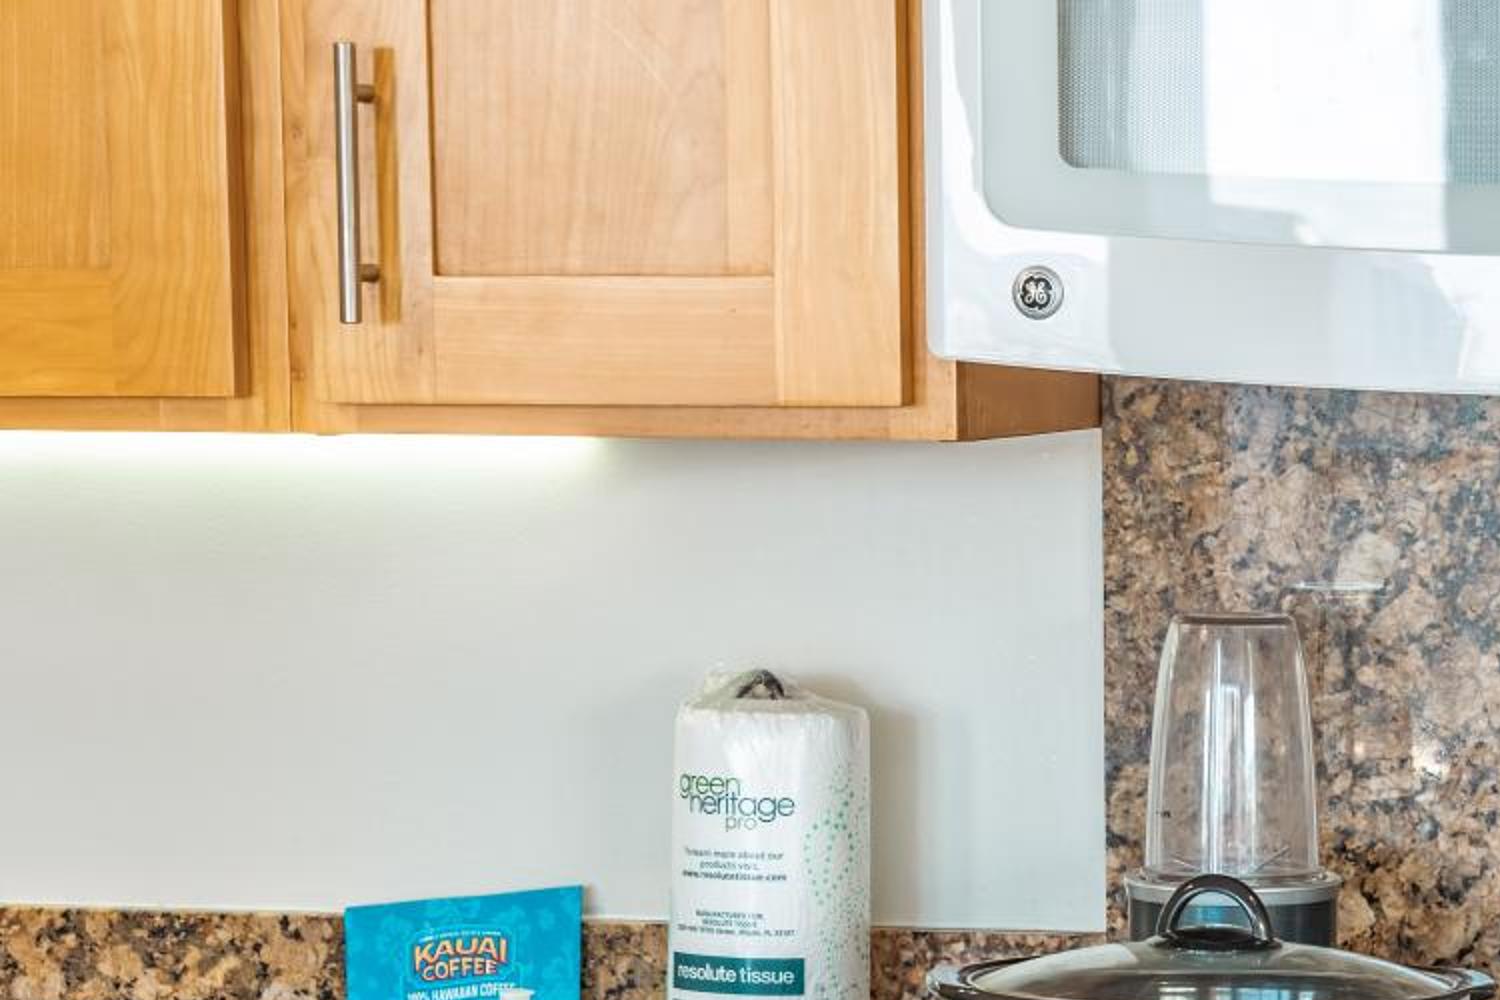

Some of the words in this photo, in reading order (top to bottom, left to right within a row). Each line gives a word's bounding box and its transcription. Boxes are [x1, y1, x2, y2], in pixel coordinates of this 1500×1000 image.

[680, 773, 741, 799] green
[690, 793, 795, 823] heritage
[725, 816, 758, 832] pro
[413, 936, 508, 973] KAUAI
[422, 956, 498, 981] COFFEE
[676, 964, 737, 982] resolute
[739, 967, 796, 985] tissue
